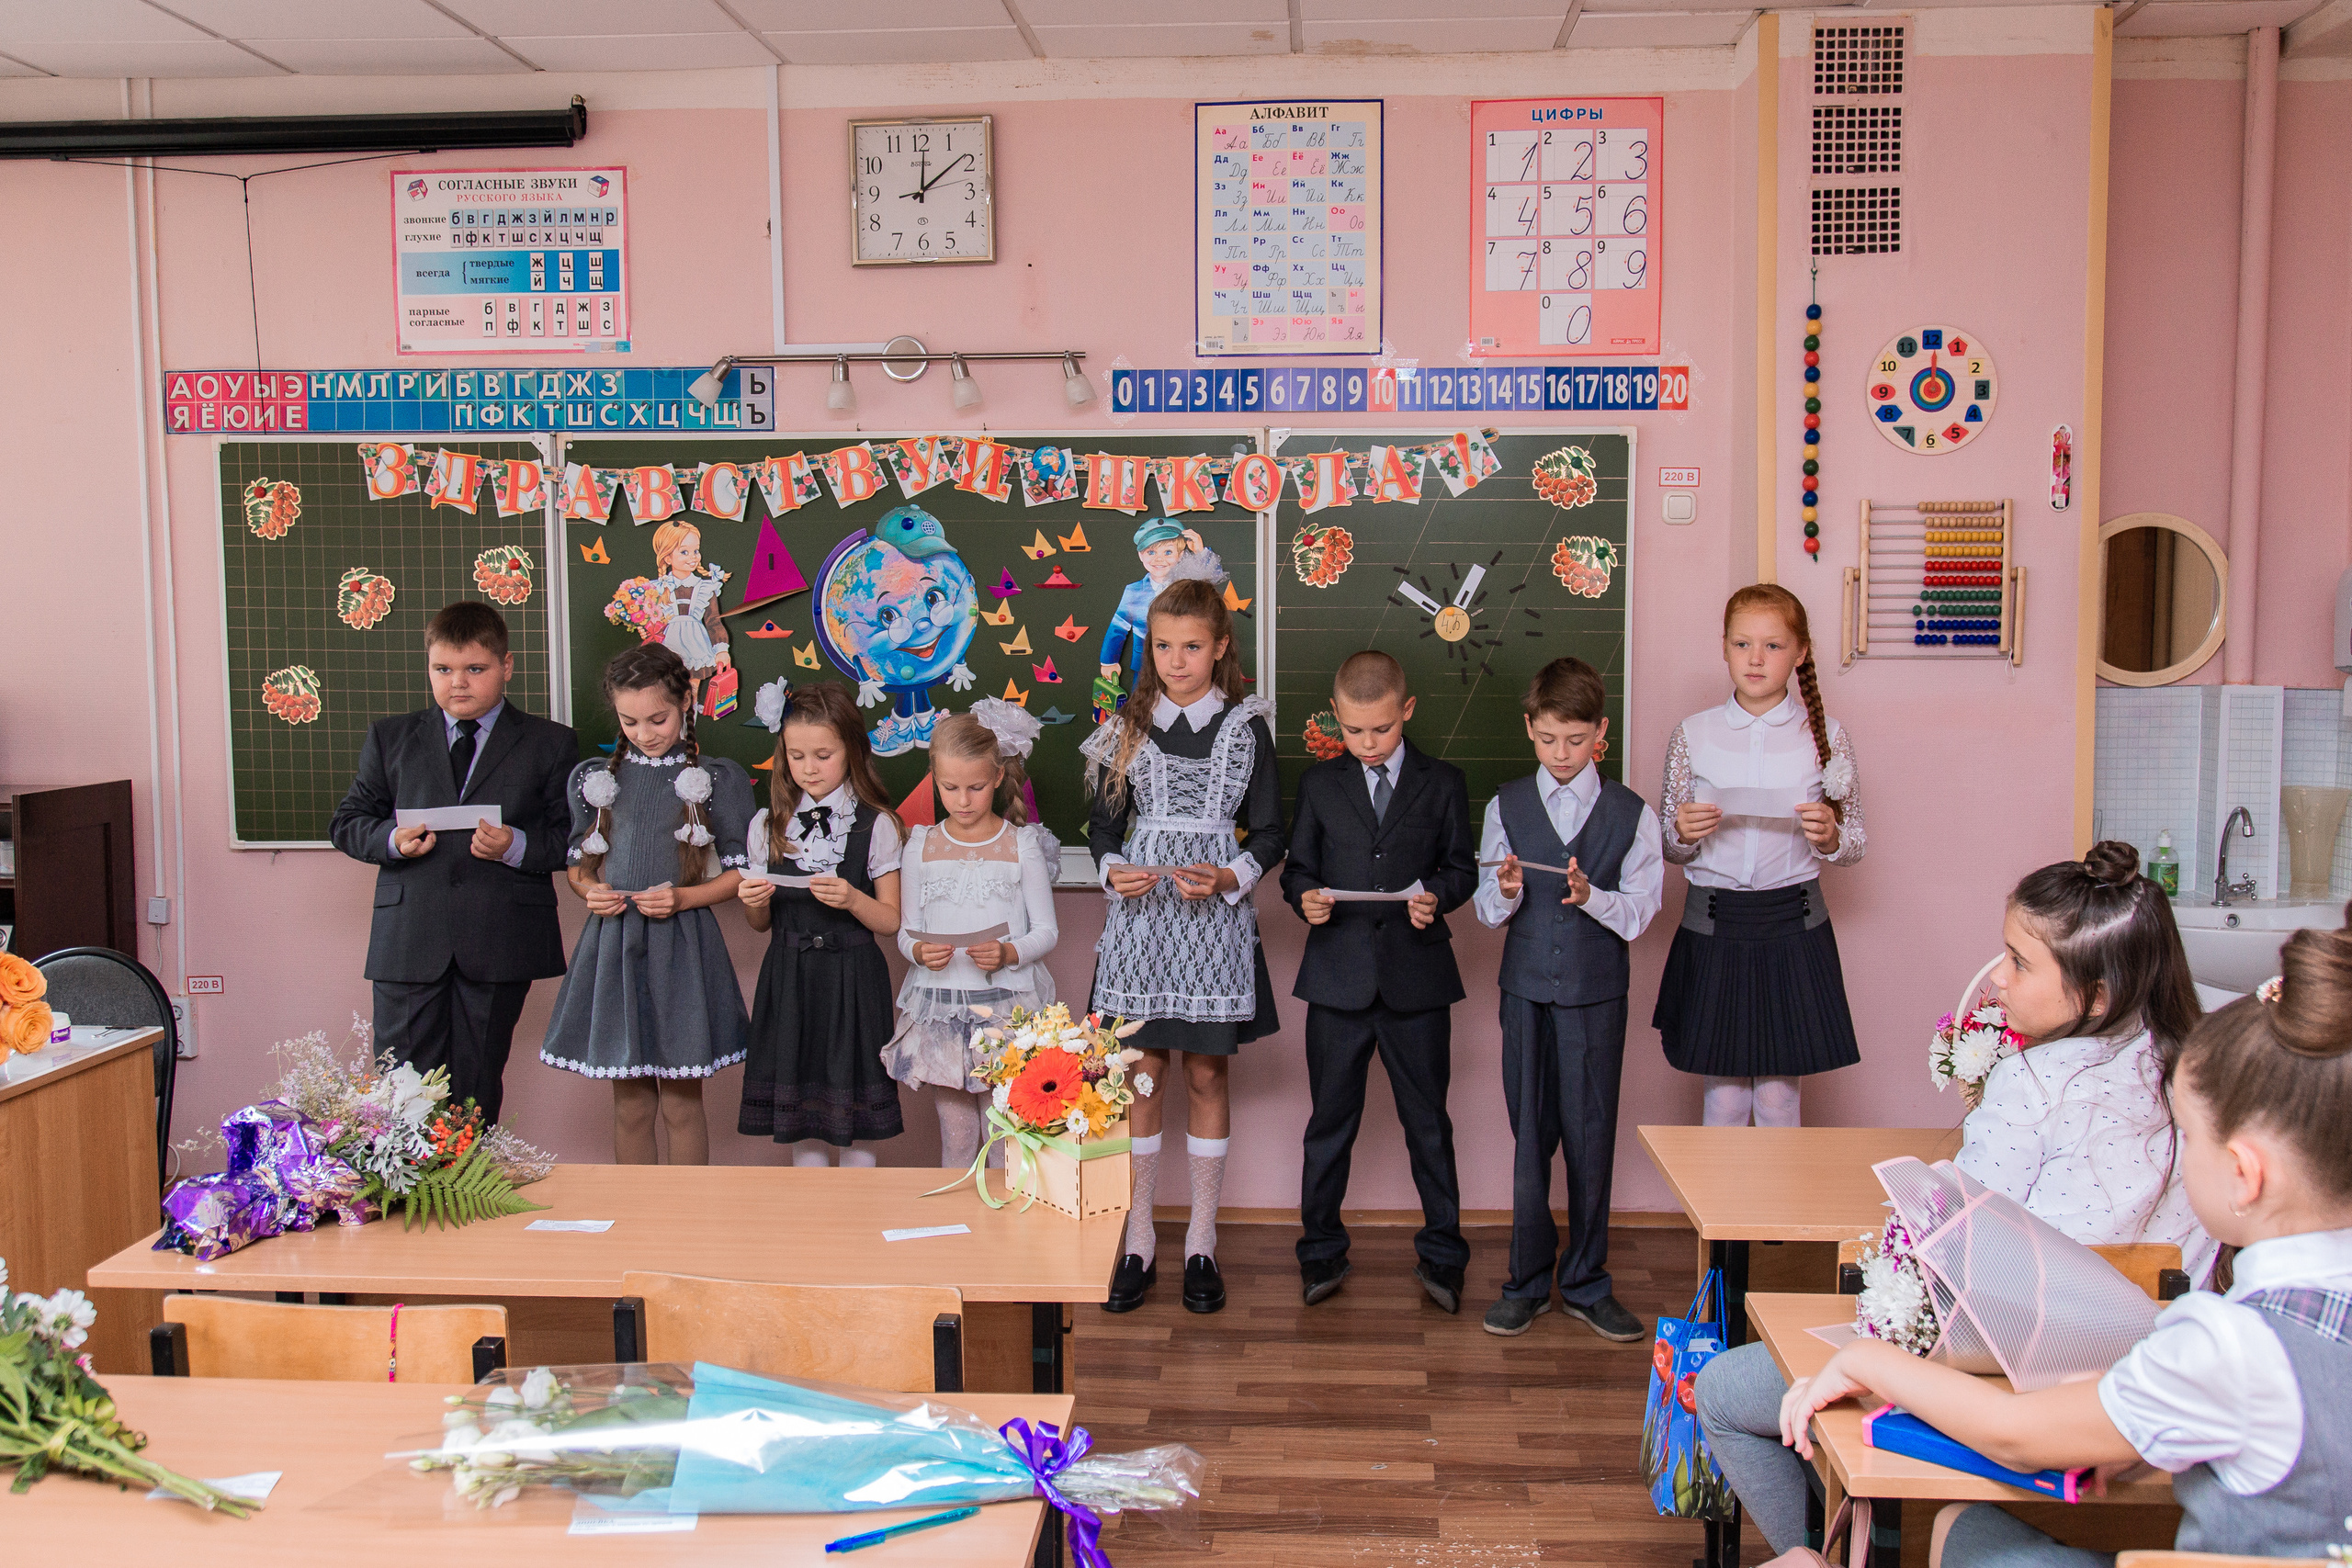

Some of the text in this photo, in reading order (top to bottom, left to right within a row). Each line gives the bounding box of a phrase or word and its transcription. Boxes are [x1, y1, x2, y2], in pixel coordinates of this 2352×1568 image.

[1250, 107, 1329, 119] АЛФАВИТ
[1532, 108, 1603, 123] ЦИФРЫ
[888, 133, 952, 152] 11 12 1
[1489, 131, 1647, 181] 1 1 2 2 3 3
[865, 156, 882, 175] 10
[964, 153, 975, 172] 2
[438, 178, 577, 190] СОГЛАСНЫЕ ЗВУКИ
[457, 193, 563, 202] РУССКОГО ЯЗЫКА
[869, 186, 879, 203] 9
[965, 183, 976, 200] 3
[1488, 186, 1646, 236] 4 4 5 5 6 6
[403, 216, 447, 224] звонкие
[870, 214, 881, 231] 8
[965, 210, 977, 228] 4
[405, 233, 441, 243] глухие
[892, 231, 956, 250] 7 6 5
[469, 259, 514, 269] твердые
[1488, 241, 1646, 290] 7 7 8 8 9 9
[416, 269, 450, 278] всегда
[469, 276, 509, 285] мягкие
[409, 308, 450, 317] парные
[410, 318, 465, 327] согласные
[1543, 297, 1590, 344] 0 0
[1924, 334, 1939, 344] 12
[1900, 342, 1962, 353] 11 1
[1881, 361, 1896, 371] 10
[1972, 362, 1980, 373] 2
[1118, 374, 1687, 406] 0 1 2 3 4 5 6 7 8 9 10 11 12 13 14 15 16 17 18 19 20
[1879, 385, 1986, 398] 9 3
[1884, 408, 1978, 419] 8 4
[1903, 428, 1960, 448] 7 6 5
[1665, 472, 1683, 481] 220
